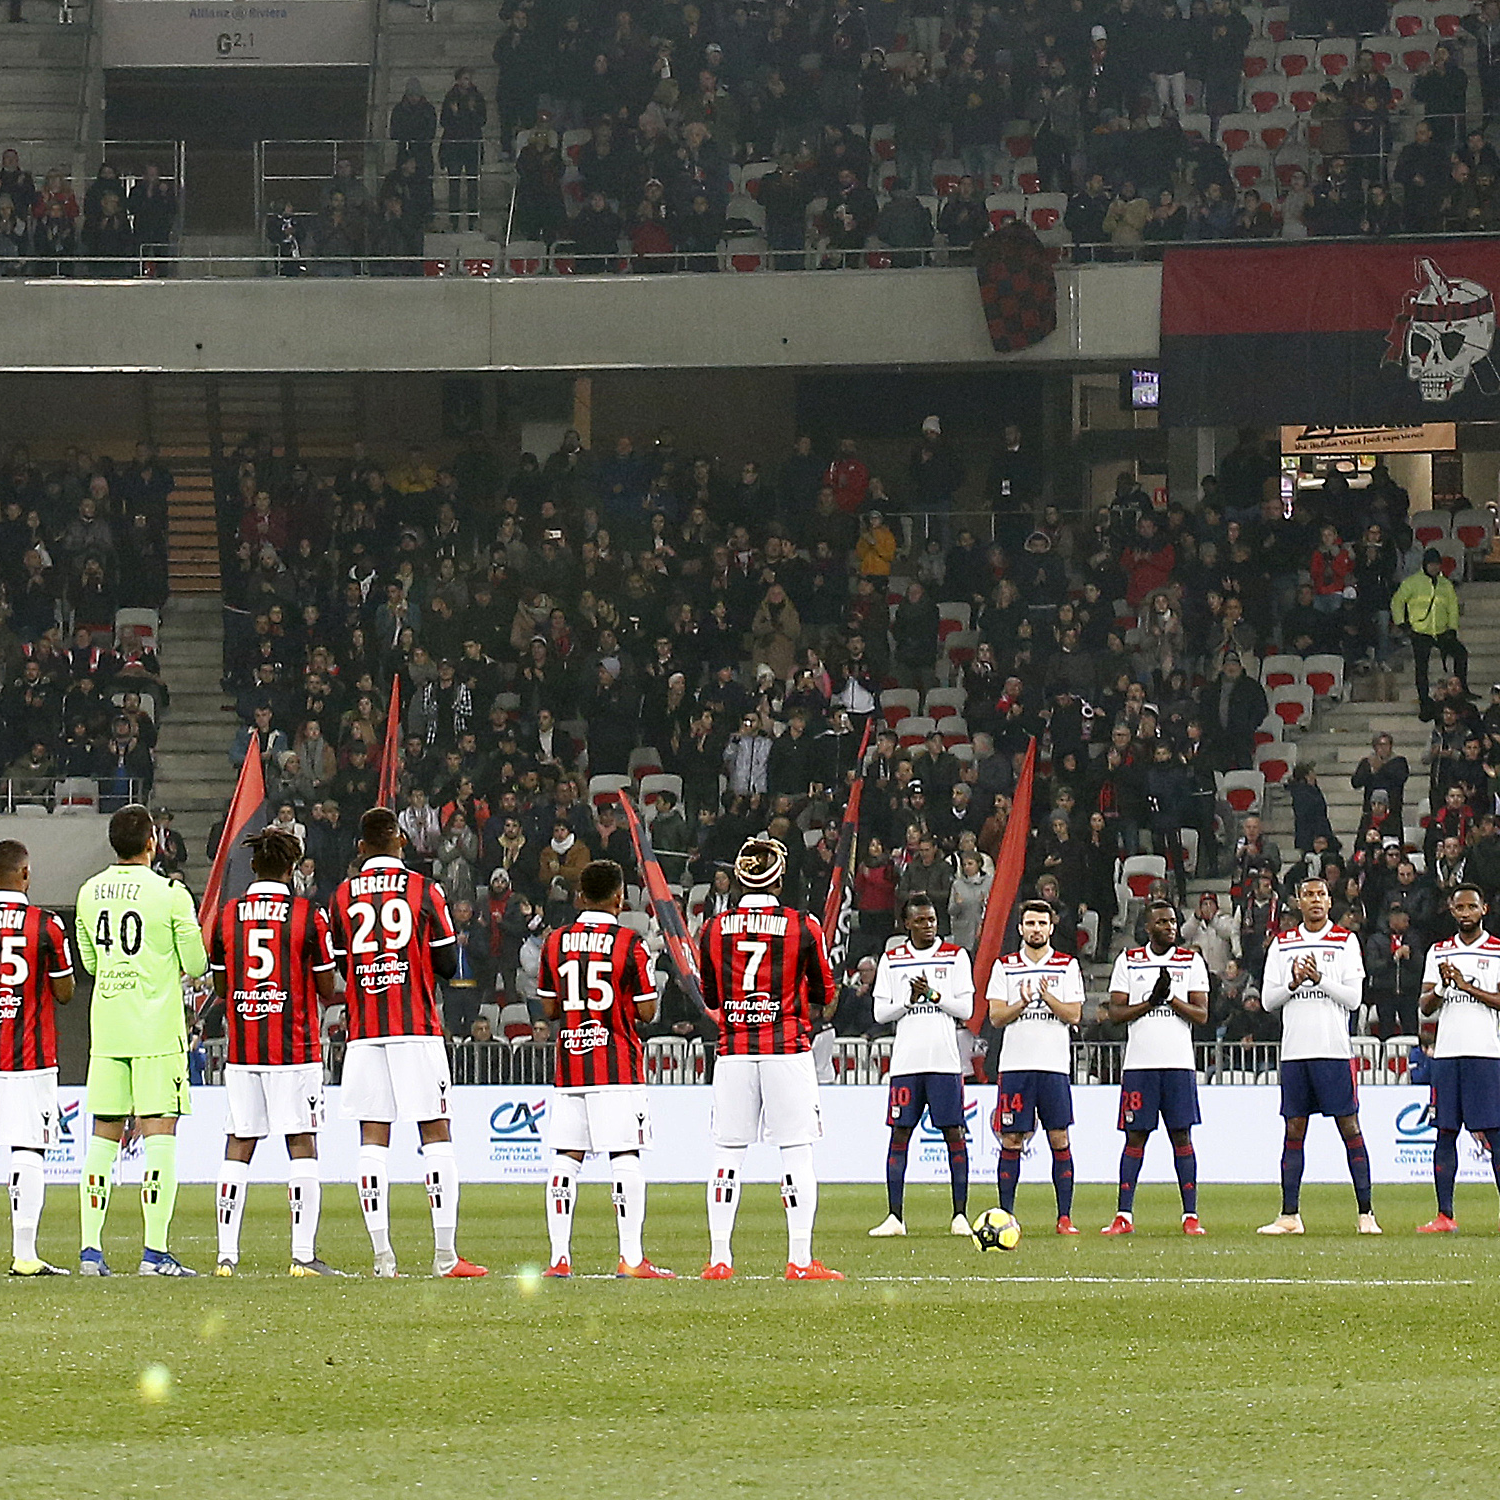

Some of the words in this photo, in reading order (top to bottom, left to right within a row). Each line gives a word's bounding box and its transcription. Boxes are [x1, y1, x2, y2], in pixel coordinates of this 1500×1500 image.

[351, 874, 408, 897] HERELLE
[237, 901, 290, 922] TAMEZE
[95, 909, 143, 956] 40
[347, 897, 413, 954] 29
[720, 913, 788, 936] SAINT-MAXIMIN
[562, 932, 614, 955] BURNER
[246, 928, 275, 980] 5
[355, 959, 409, 975] mutuelles
[737, 940, 767, 991] 7
[361, 975, 376, 987] du
[376, 972, 406, 986] soleil
[557, 959, 614, 1012] 15
[233, 989, 288, 1001] mutuelles
[236, 1002, 253, 1014] du
[254, 1000, 284, 1014] soleil
[724, 999, 780, 1012] mutuelles
[727, 1011, 745, 1023] du
[746, 1011, 777, 1023] soleil
[564, 1037, 580, 1049] du
[581, 1035, 608, 1048] soleil
[890, 1086, 911, 1106] 10
[1001, 1093, 1023, 1113] 14
